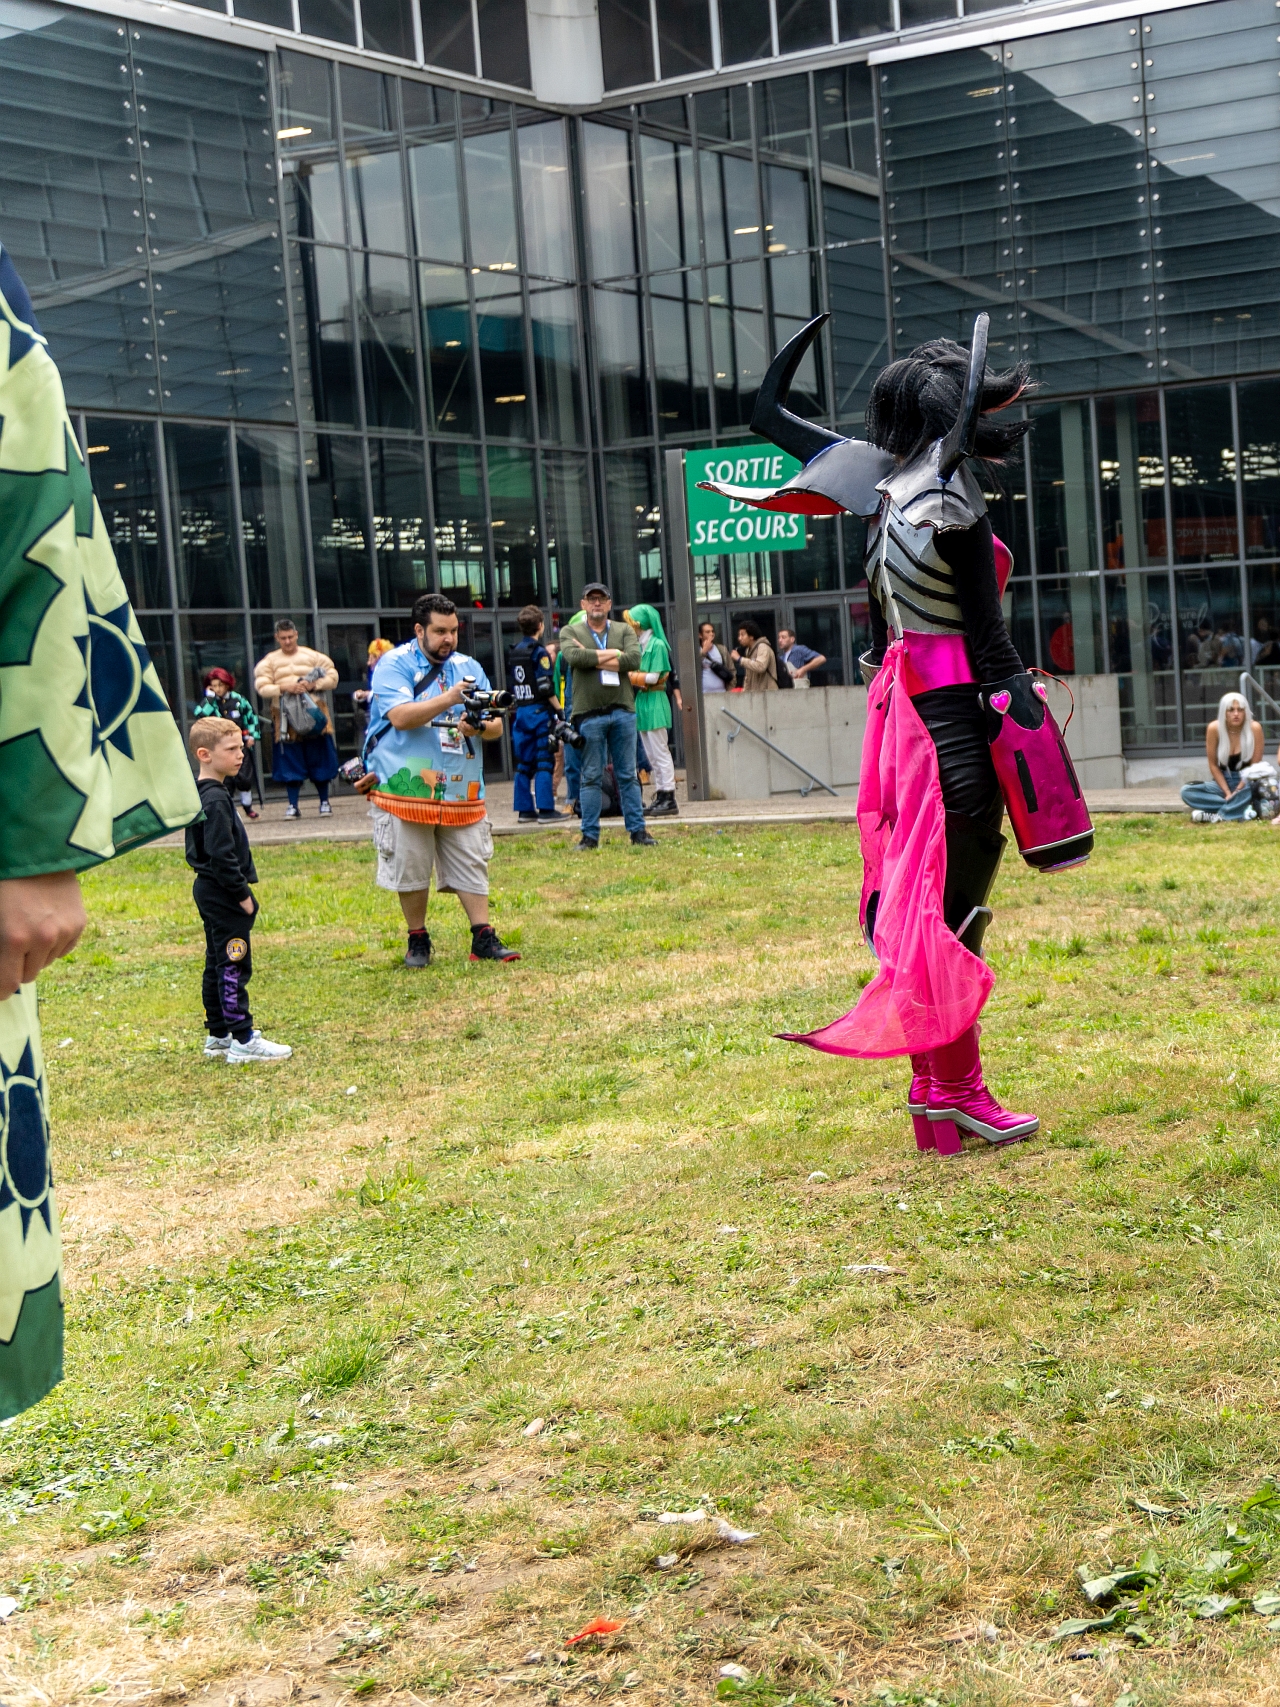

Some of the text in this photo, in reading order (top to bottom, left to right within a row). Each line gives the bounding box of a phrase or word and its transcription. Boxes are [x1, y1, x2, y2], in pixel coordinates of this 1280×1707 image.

[704, 456, 784, 483] SORTIE
[694, 514, 800, 544] SECOURS
[1197, 526, 1239, 537] PAINTIN
